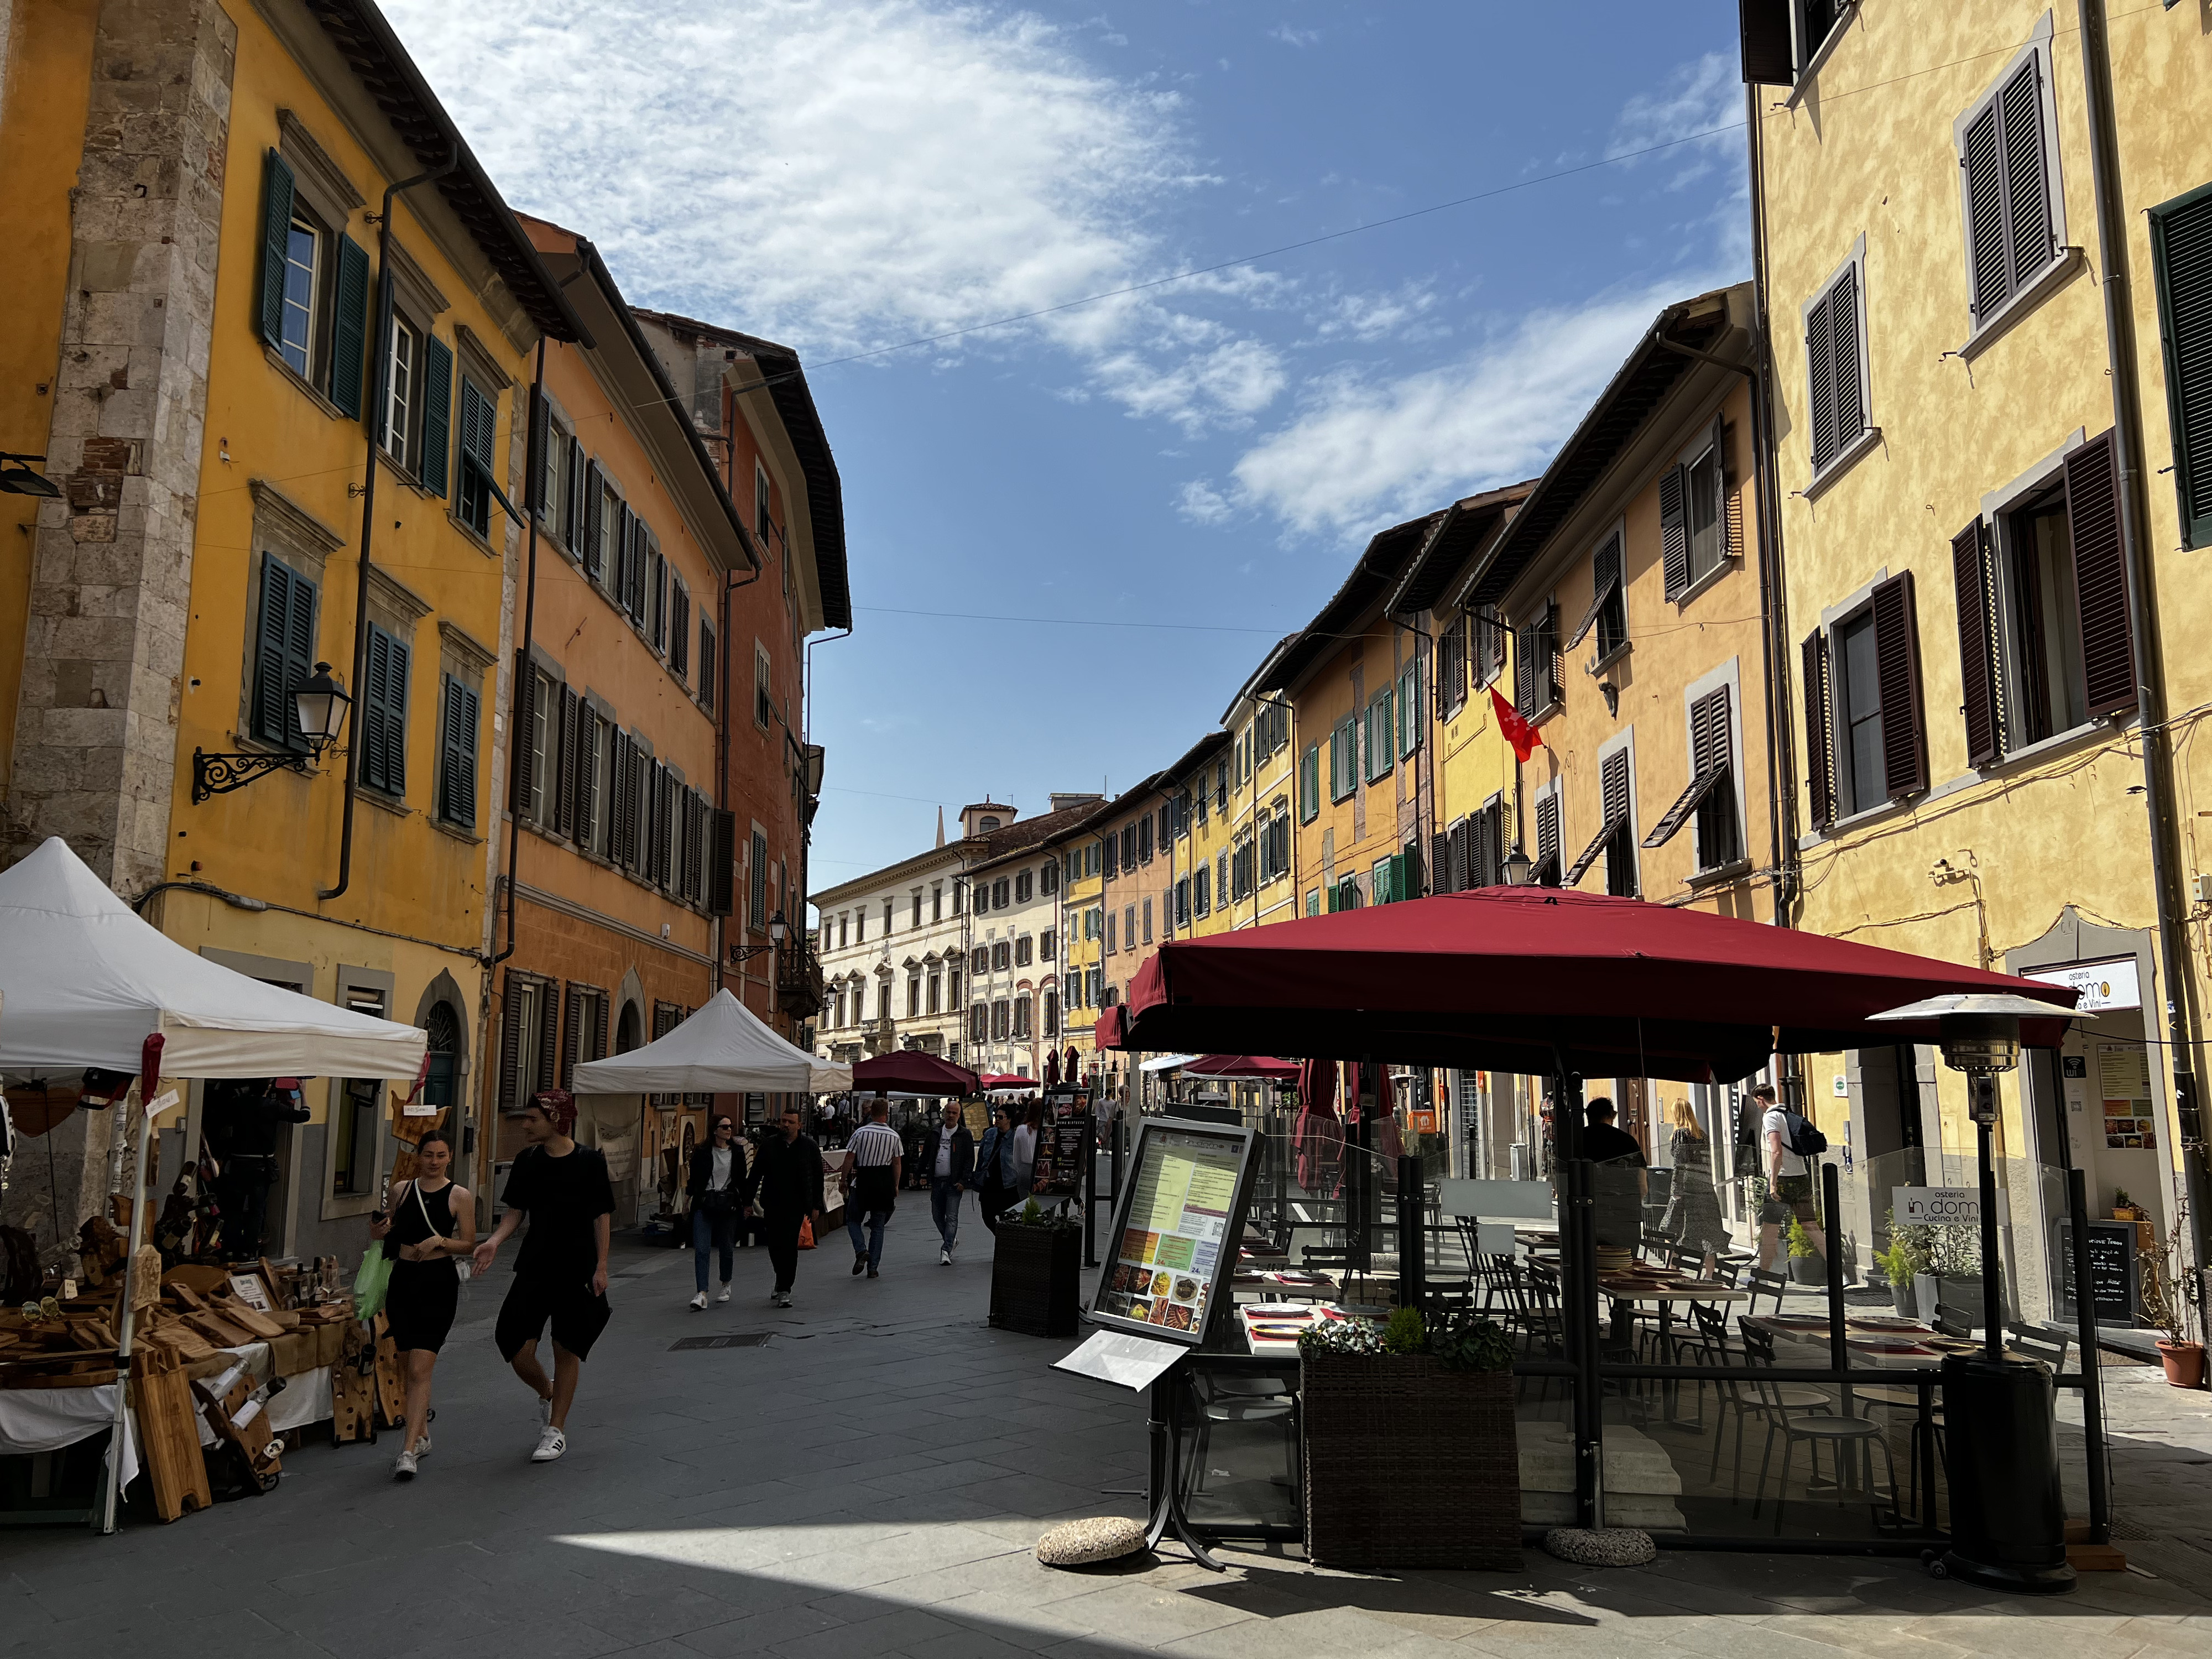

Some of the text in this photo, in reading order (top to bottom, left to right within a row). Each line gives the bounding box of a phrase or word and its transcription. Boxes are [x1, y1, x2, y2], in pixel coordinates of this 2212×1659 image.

[2069, 971, 2090, 980] osteria
[2089, 999, 2101, 1008] Vini
[1908, 1197, 1979, 1214] in dom
